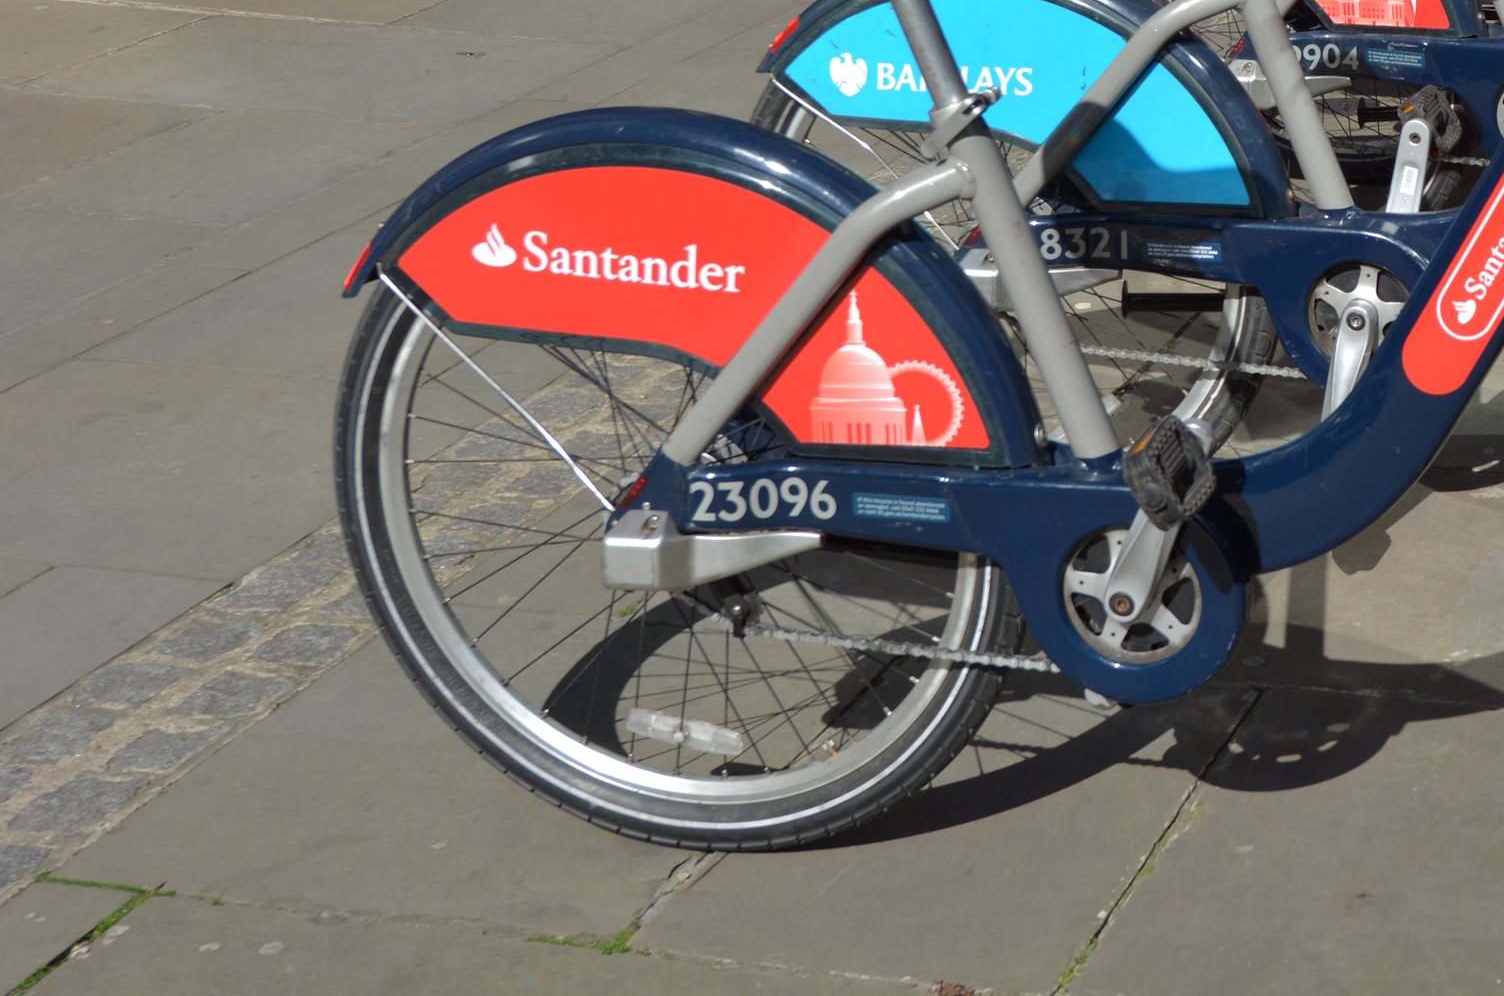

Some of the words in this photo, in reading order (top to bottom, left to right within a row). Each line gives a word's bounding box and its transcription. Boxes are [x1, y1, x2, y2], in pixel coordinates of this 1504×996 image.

[876, 62, 1033, 96] BALAYS
[523, 230, 746, 293] Santander
[1040, 226, 1128, 260] 8321
[689, 476, 837, 522] 23096
